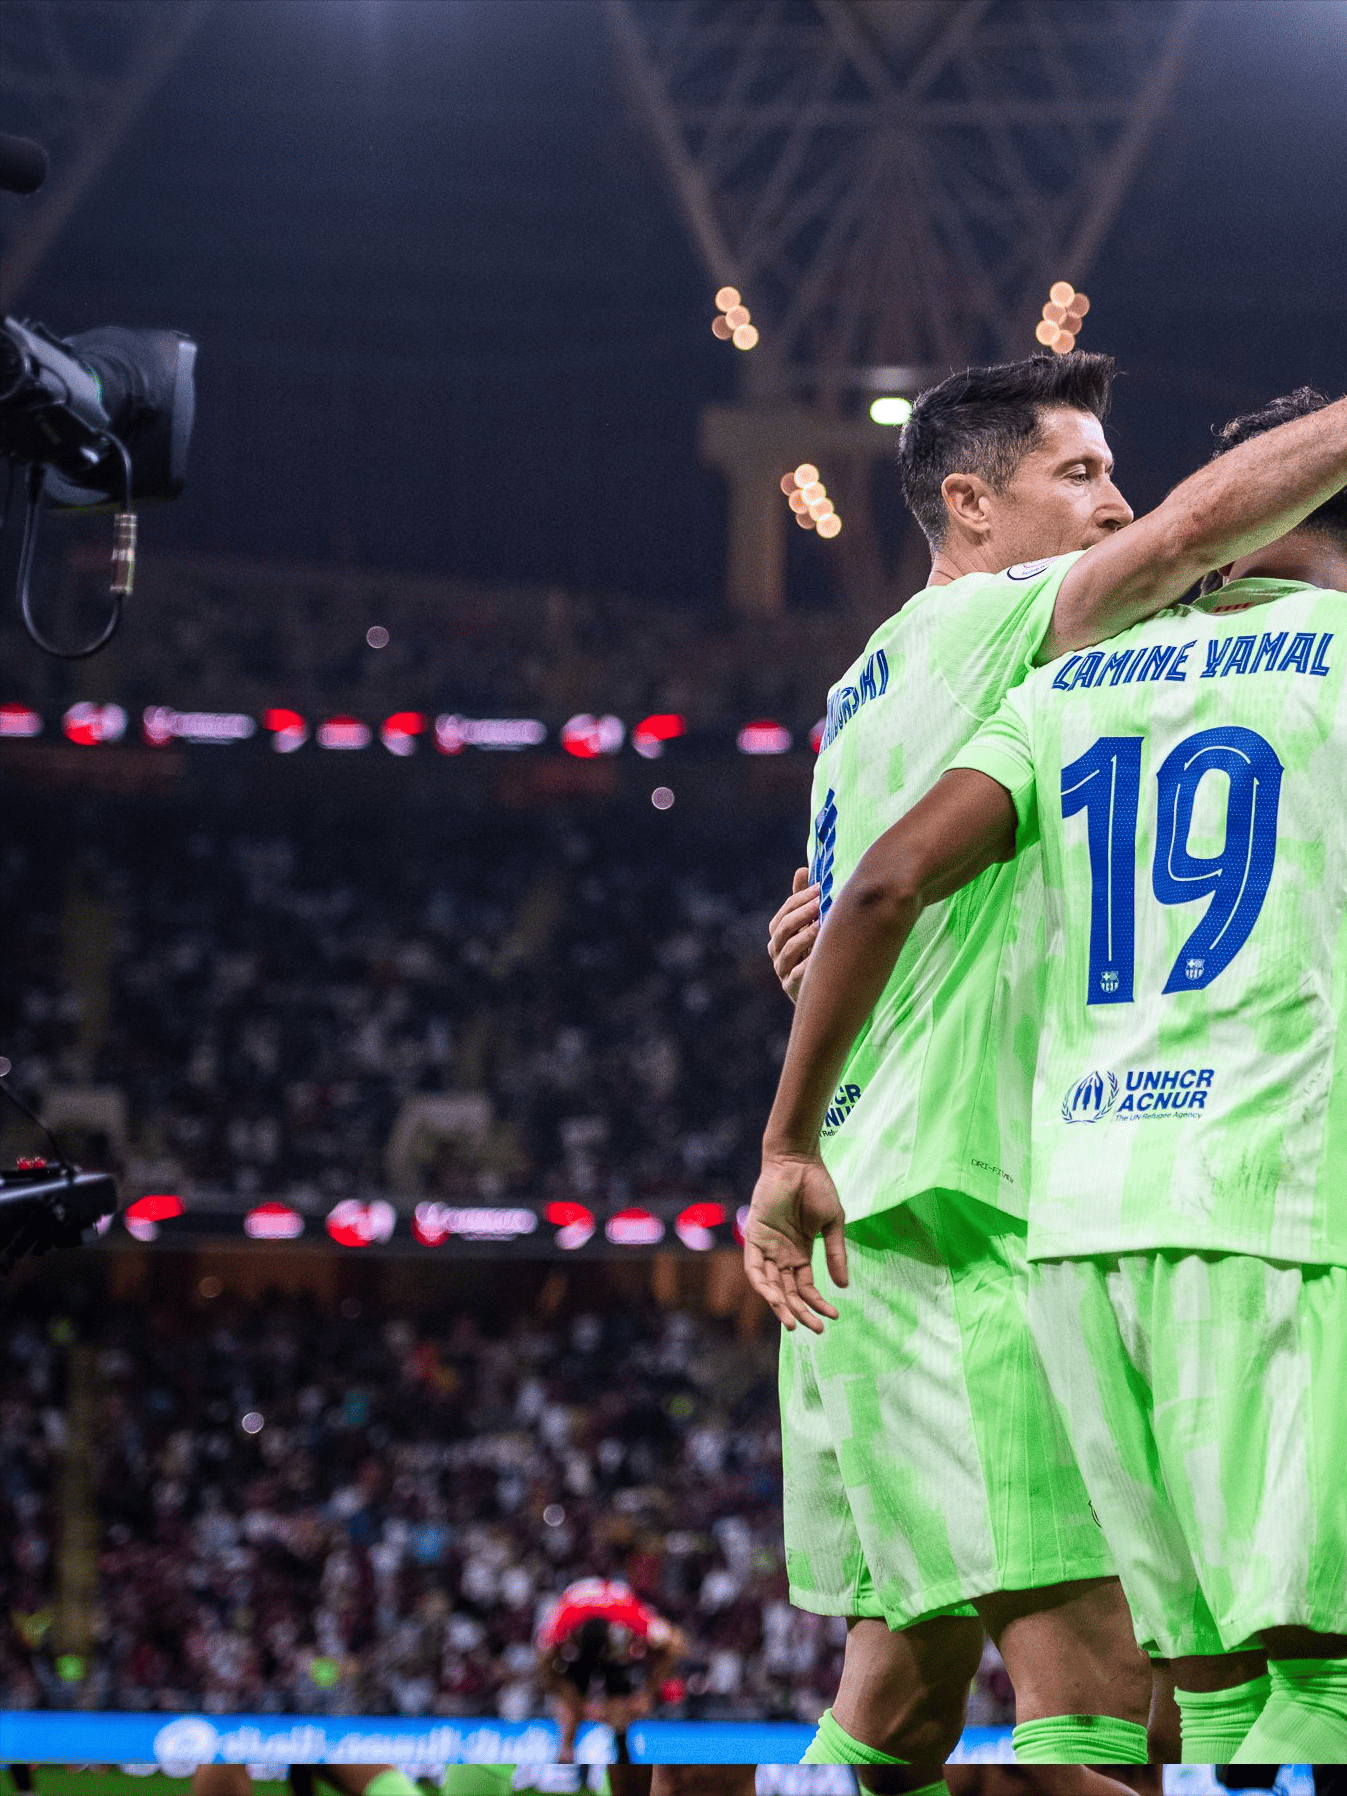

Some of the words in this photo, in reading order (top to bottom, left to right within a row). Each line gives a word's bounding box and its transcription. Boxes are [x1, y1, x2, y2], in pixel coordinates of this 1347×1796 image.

[1051, 639, 1198, 692] LAMINE
[1199, 631, 1334, 678] YAMAL
[1060, 725, 1285, 1005] 19
[1125, 1069, 1215, 1091] UNHCR
[1116, 1090, 1208, 1112] ACNUR
[1142, 1112, 1171, 1120] Refugee
[1172, 1111, 1202, 1119] Agency
